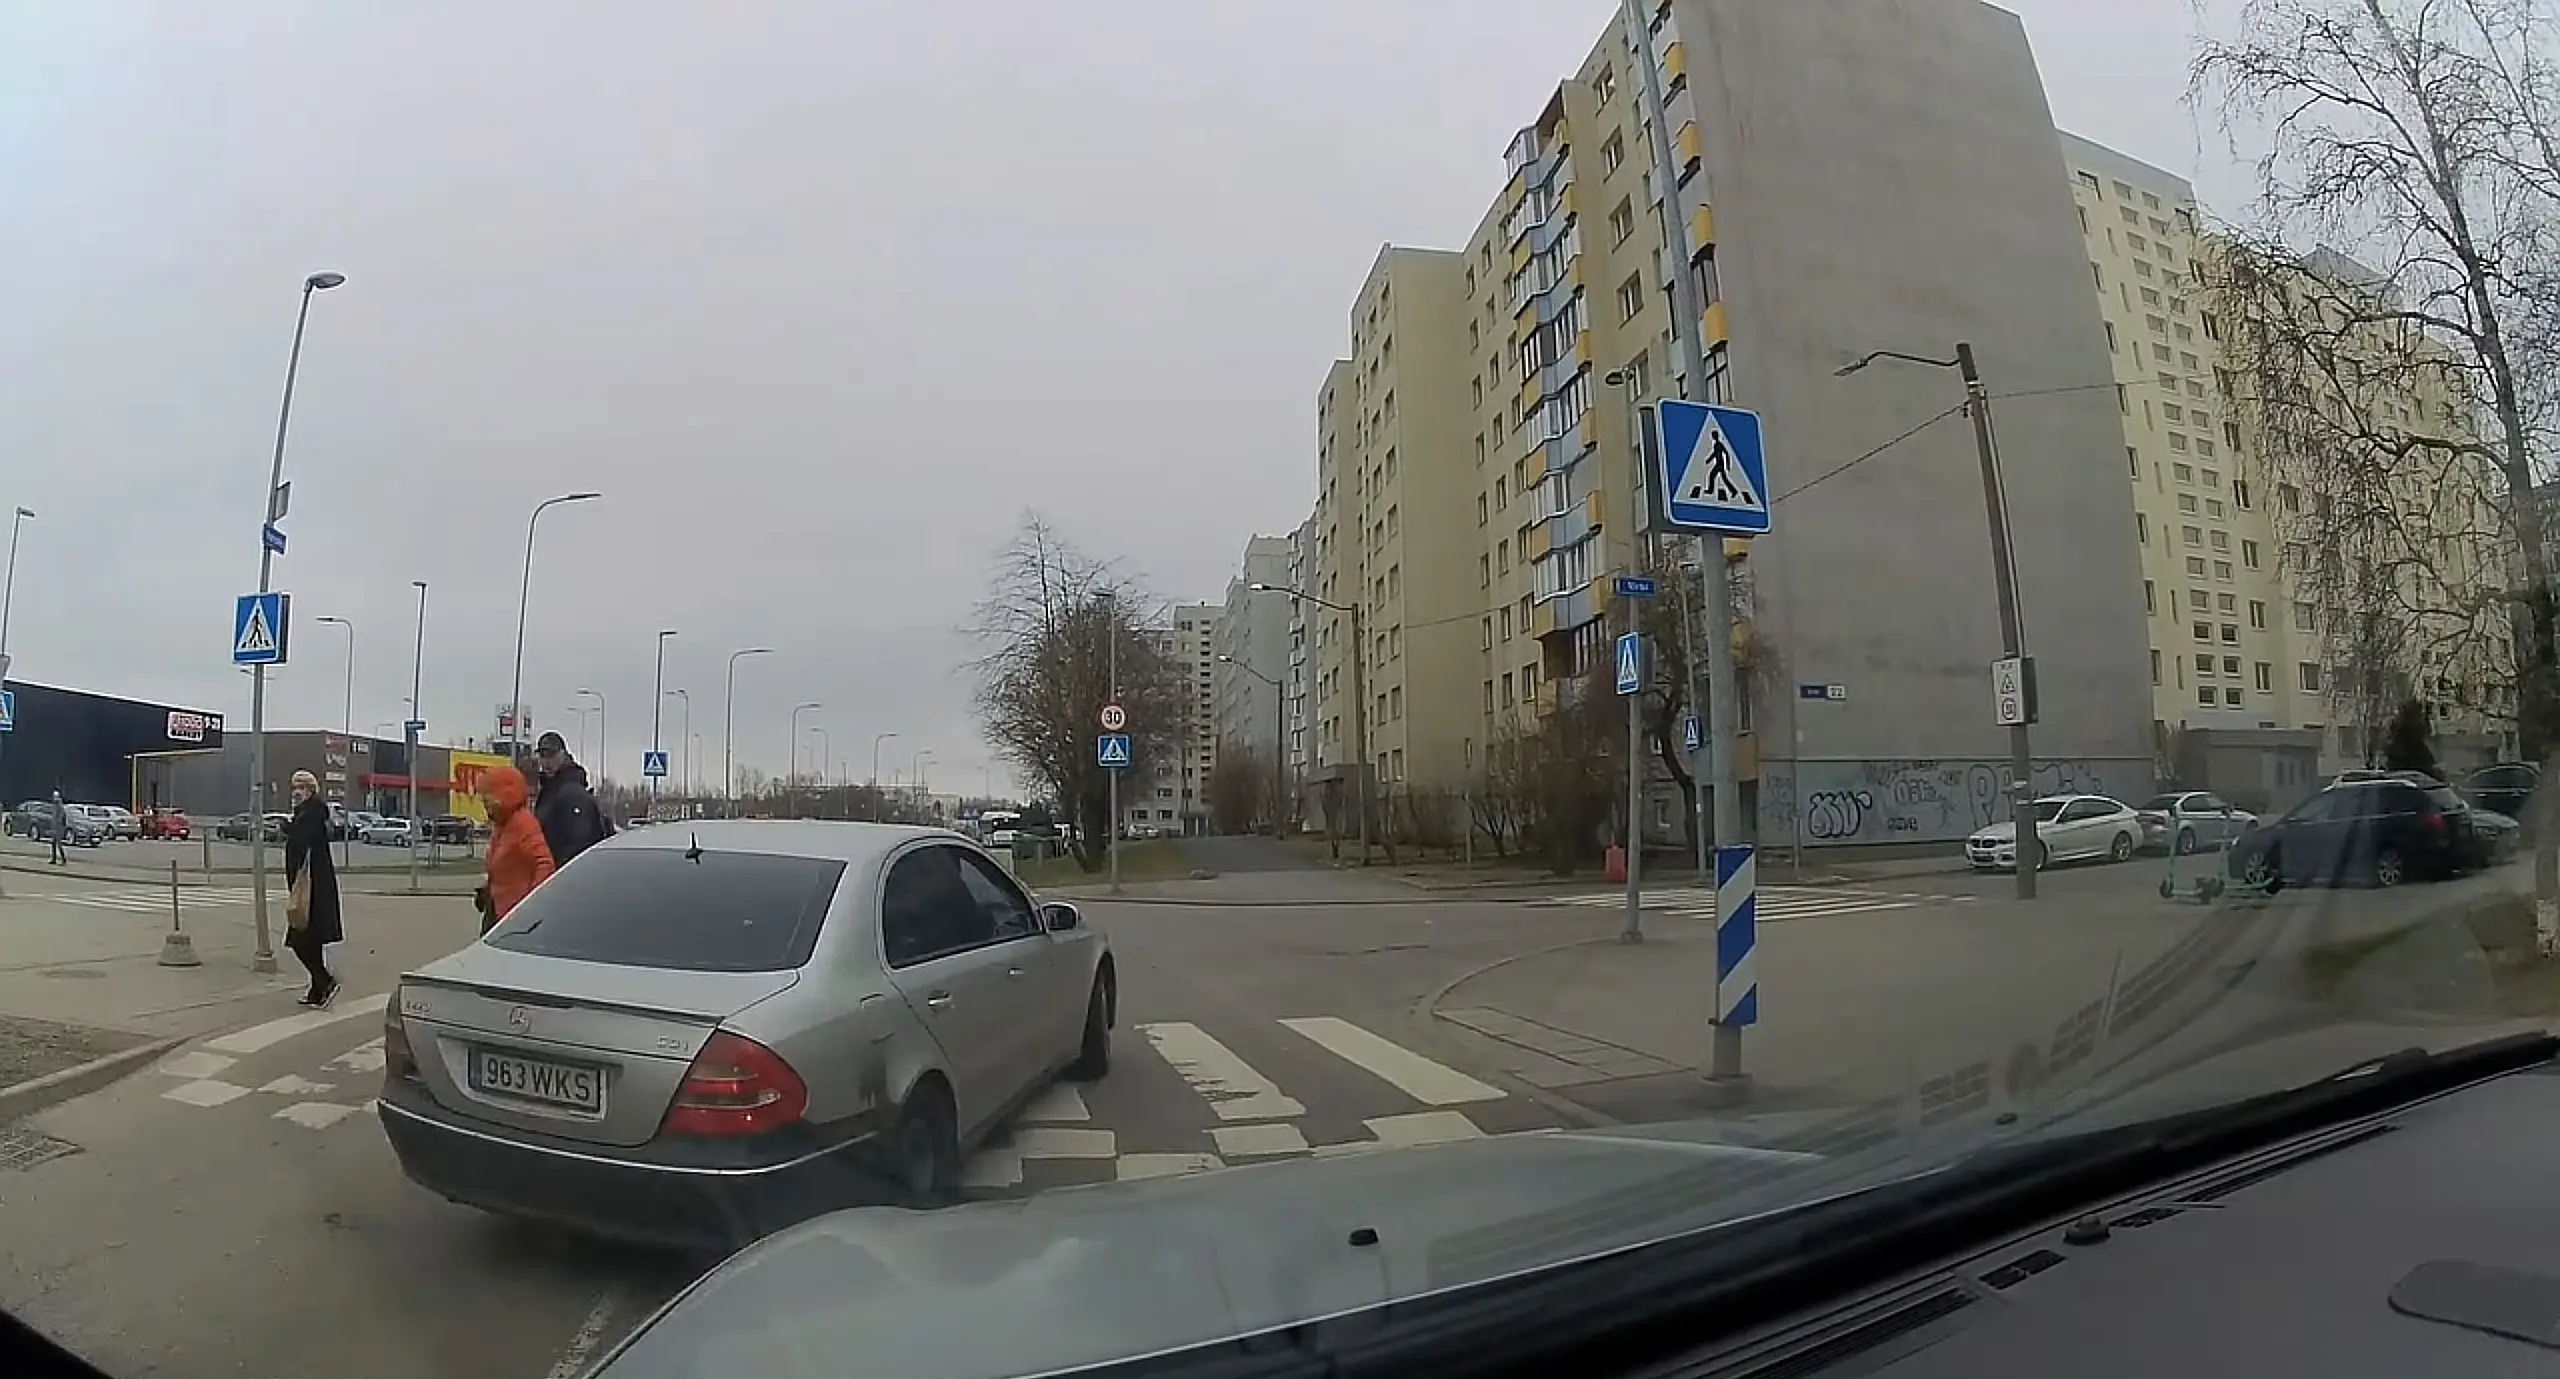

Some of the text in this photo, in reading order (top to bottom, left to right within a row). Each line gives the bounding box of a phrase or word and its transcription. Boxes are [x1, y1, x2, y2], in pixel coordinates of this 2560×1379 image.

[1105, 709, 1120, 725] 30
[487, 1057, 590, 1101] 963 WKS
